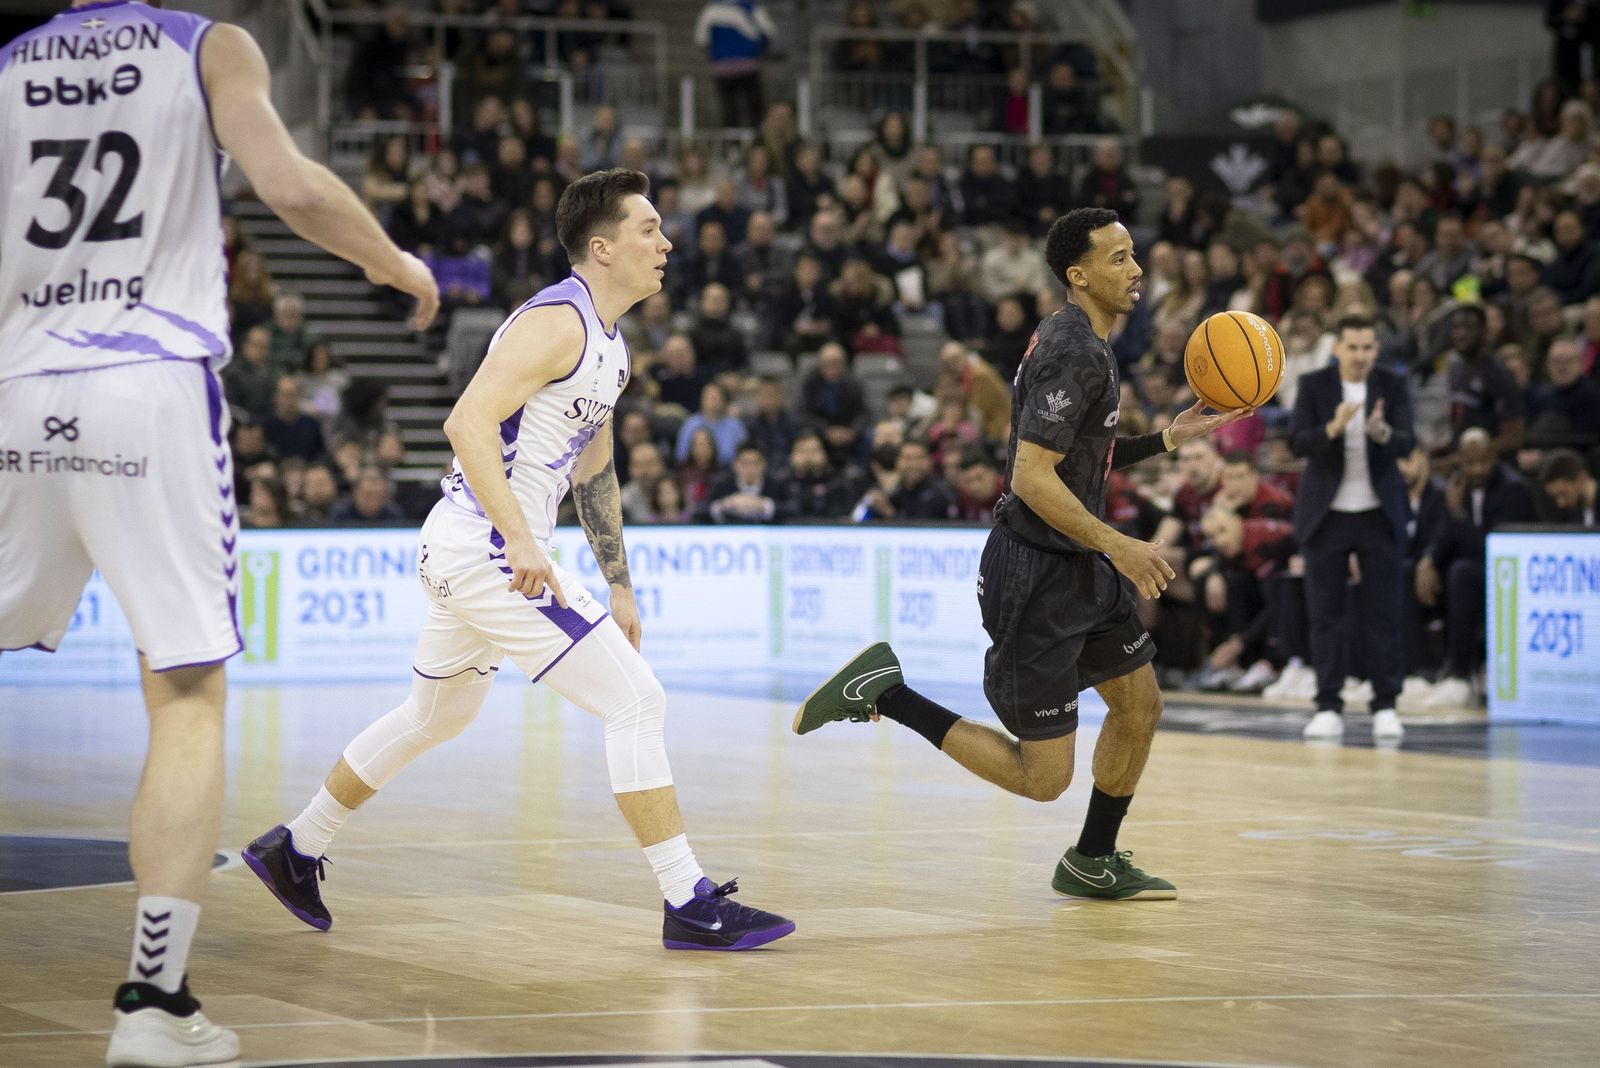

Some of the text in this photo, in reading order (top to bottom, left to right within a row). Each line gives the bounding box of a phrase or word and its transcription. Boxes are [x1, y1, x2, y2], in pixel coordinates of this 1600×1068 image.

[25, 77, 107, 107] bbk
[25, 130, 144, 250] 32
[29, 451, 148, 478] Financial
[577, 542, 762, 576] GANADA
[299, 590, 385, 629] 2031
[1529, 610, 1584, 658] 2031
[1035, 708, 1059, 718] vive
